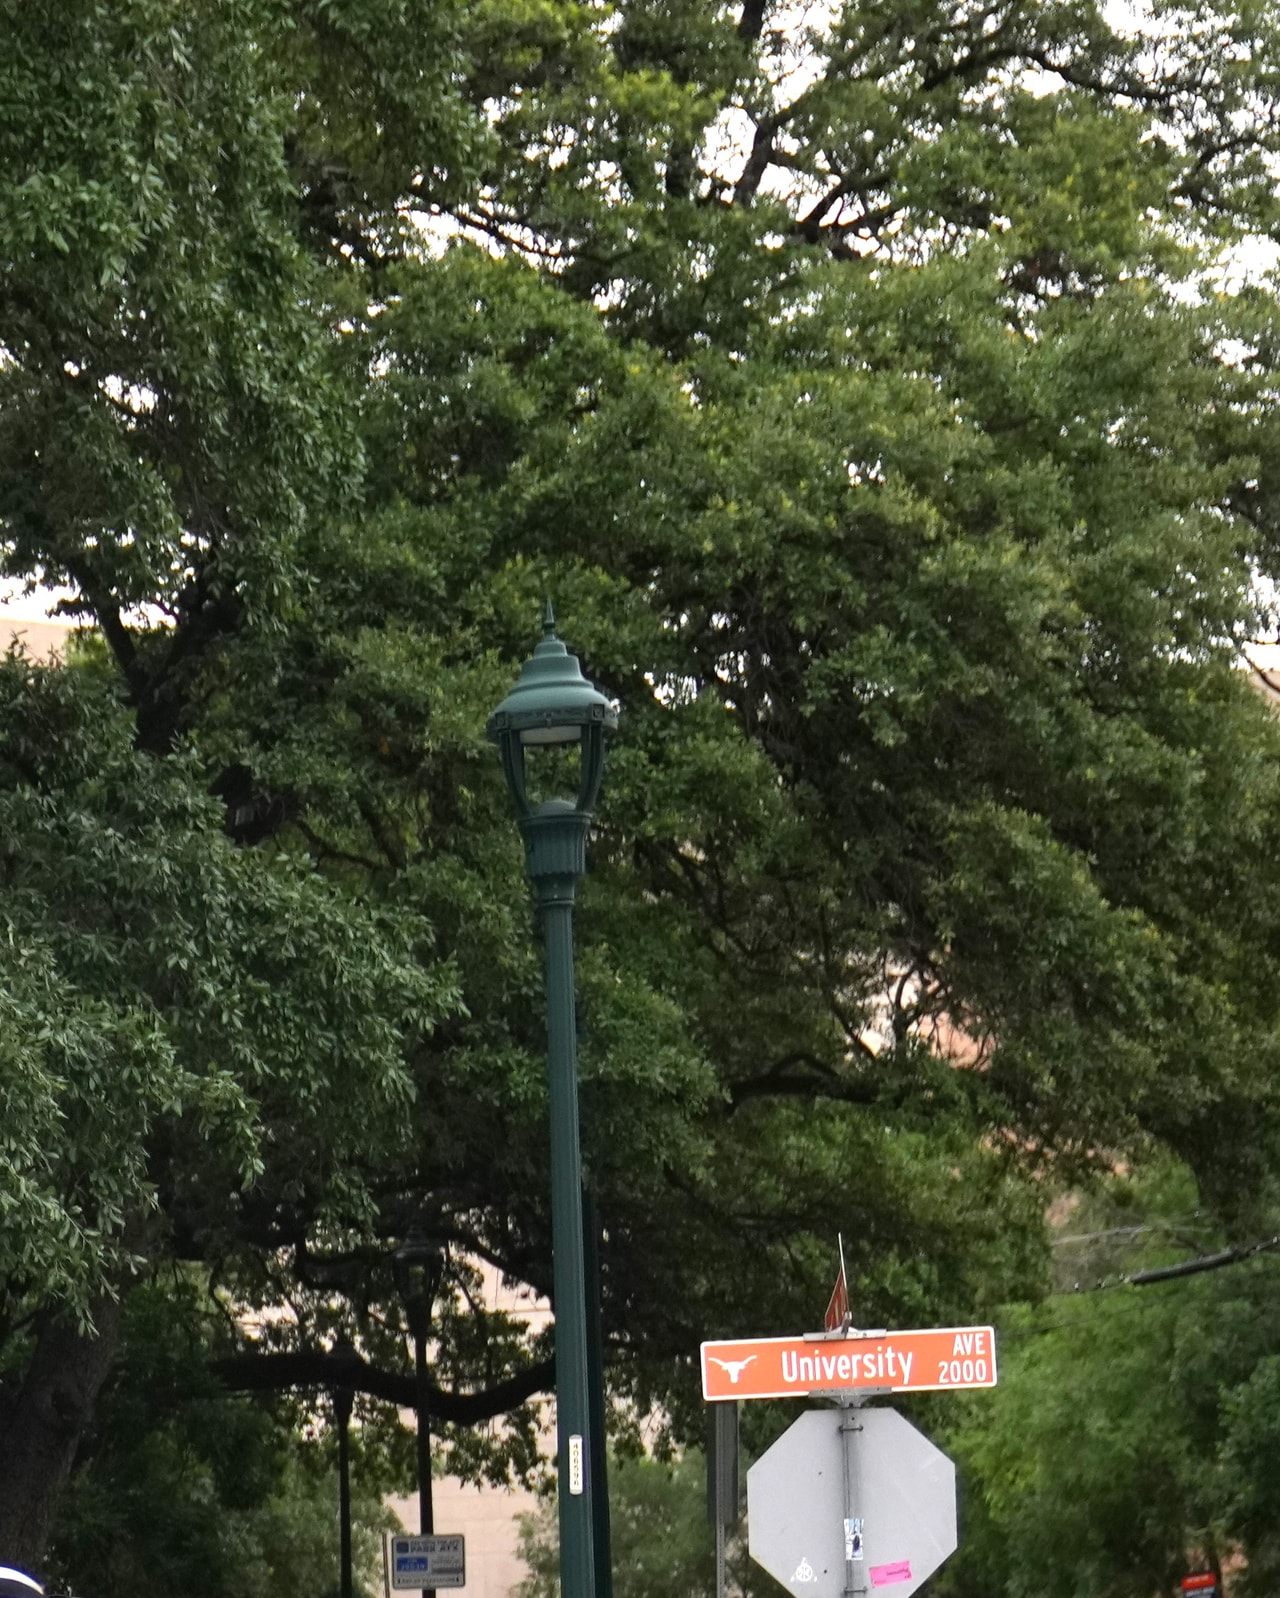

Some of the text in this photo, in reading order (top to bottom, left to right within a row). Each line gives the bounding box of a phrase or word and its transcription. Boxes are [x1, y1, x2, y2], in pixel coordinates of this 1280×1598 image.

[953, 1333, 985, 1356] AVE
[782, 1346, 913, 1384] University
[938, 1359, 987, 1384] 2000
